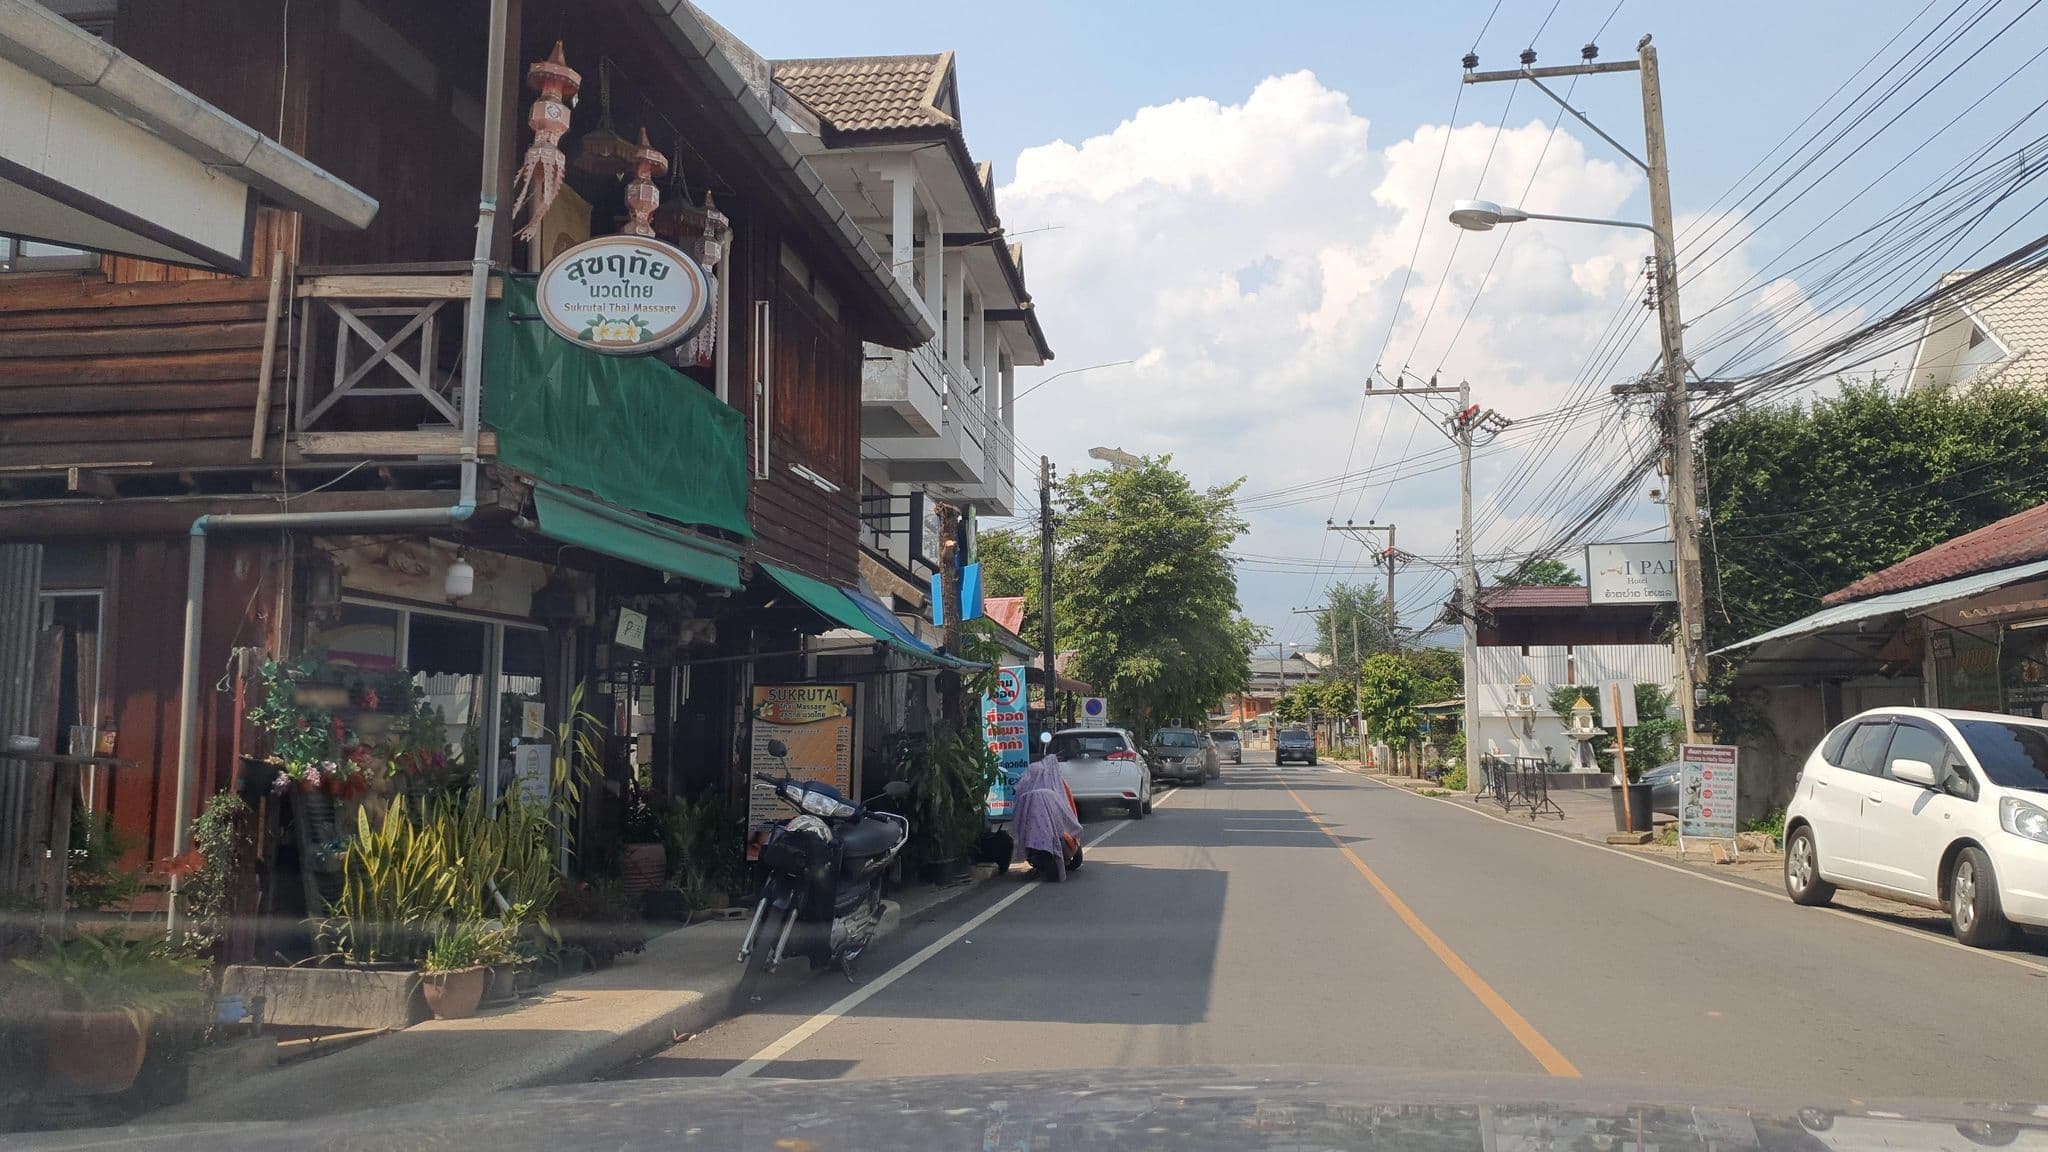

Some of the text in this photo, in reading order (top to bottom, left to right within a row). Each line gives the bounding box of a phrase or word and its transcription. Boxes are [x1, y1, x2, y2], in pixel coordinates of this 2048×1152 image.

[564, 249, 670, 286] สุขฤทัย
[590, 279, 653, 298] นวดไทย
[609, 303, 629, 312] Thai
[633, 303, 677, 314] Massage
[768, 688, 838, 701] SUKRUTAI
[796, 703, 827, 711] Massage
